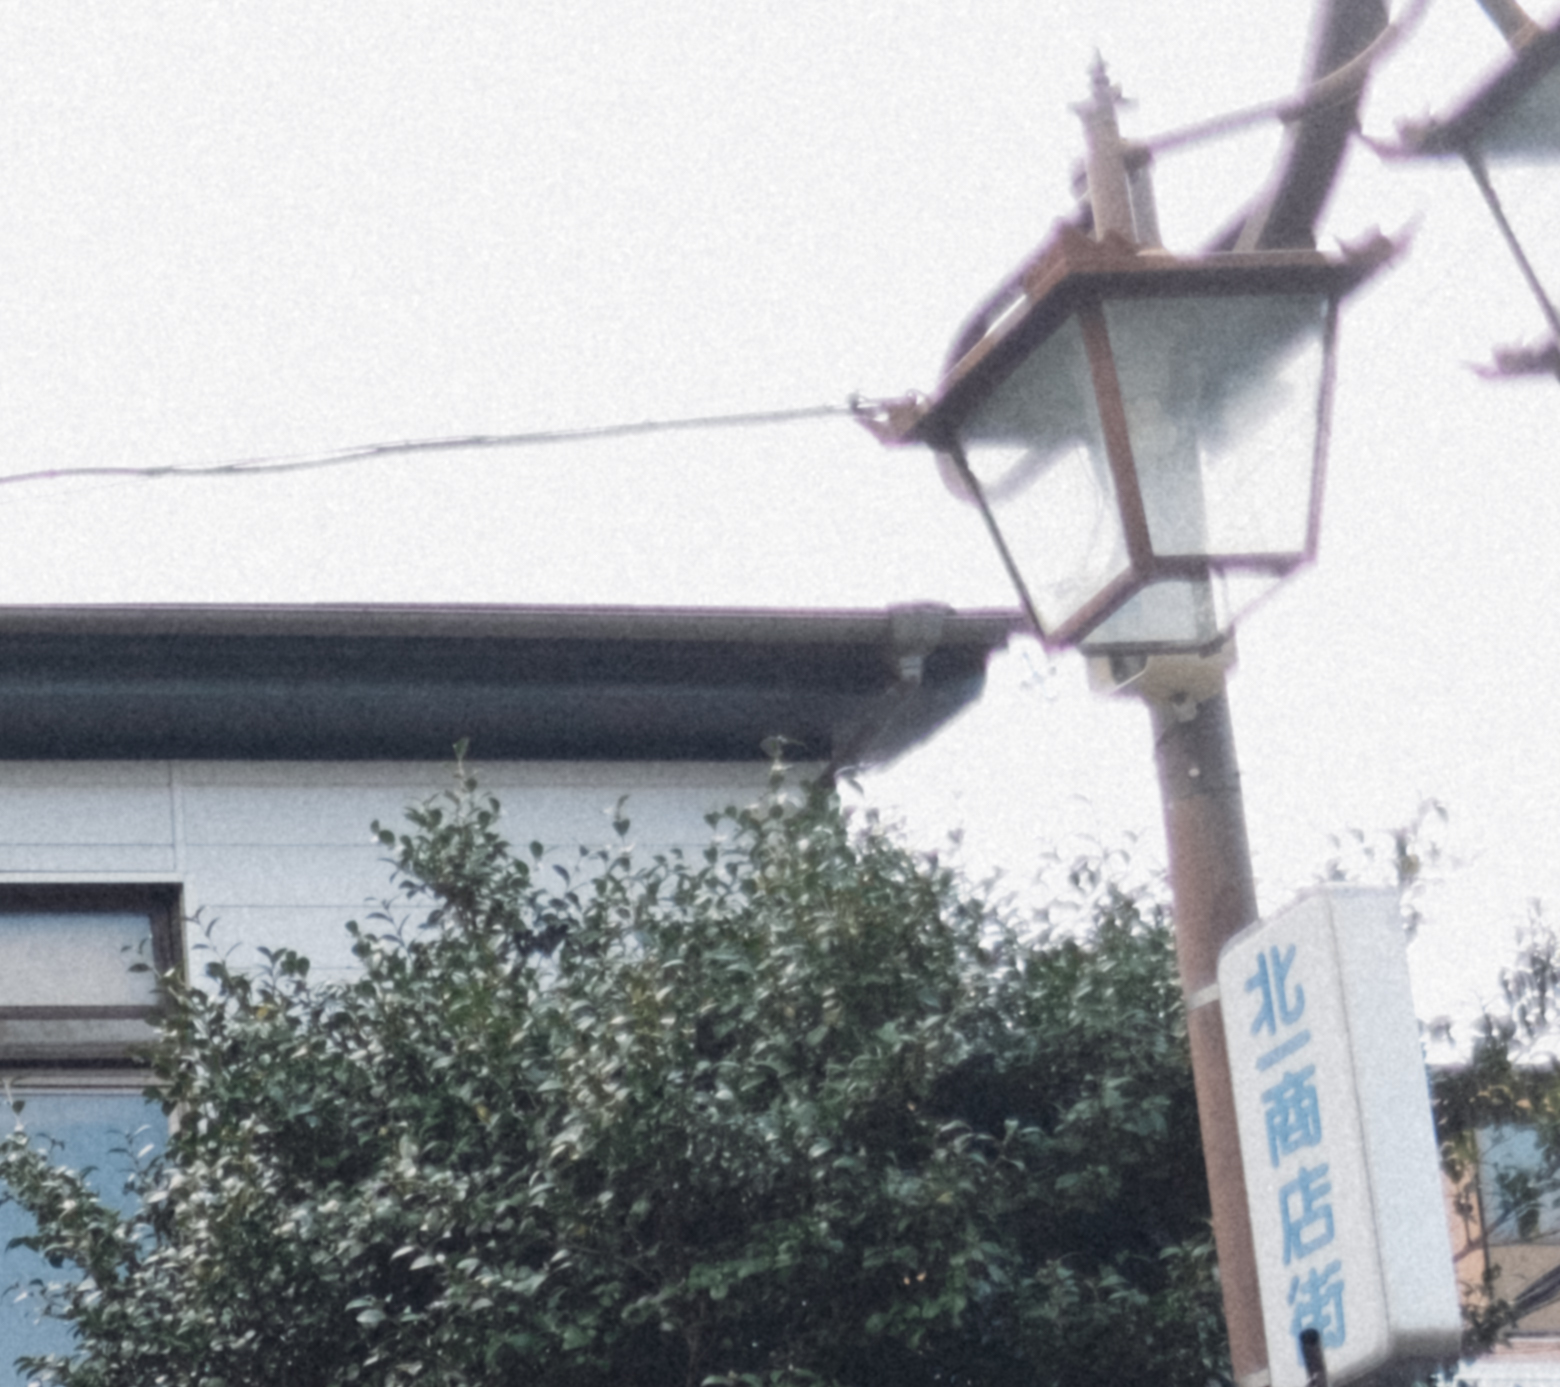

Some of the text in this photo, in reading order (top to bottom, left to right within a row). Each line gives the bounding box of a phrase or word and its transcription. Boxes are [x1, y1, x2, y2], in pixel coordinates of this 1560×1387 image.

[1243, 943, 1347, 1367] 北一商店街
